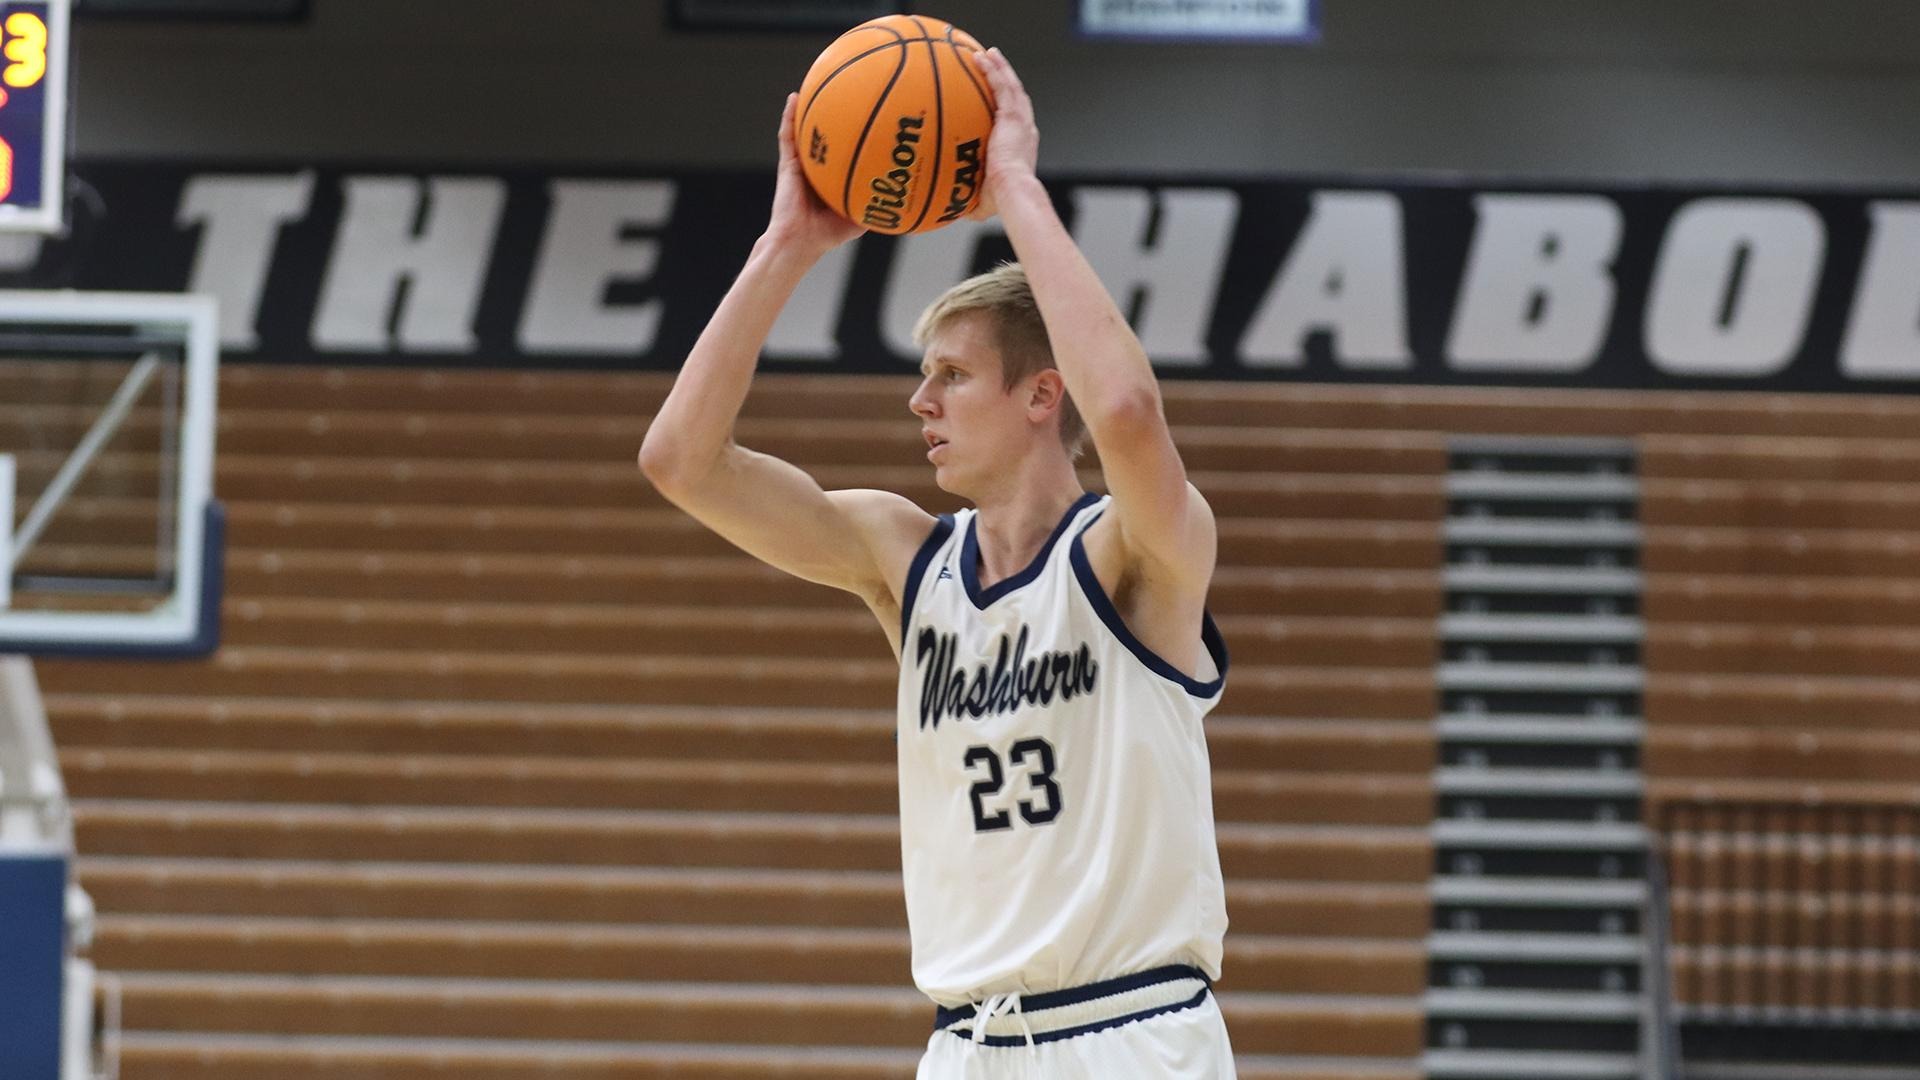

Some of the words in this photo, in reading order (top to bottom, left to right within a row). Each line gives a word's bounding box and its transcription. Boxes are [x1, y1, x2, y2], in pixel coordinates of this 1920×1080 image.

[0, 12, 48, 88] 3
[862, 115, 924, 229] Wilson
[936, 137, 982, 223] NCAA
[175, 171, 678, 355] THE
[916, 622, 1099, 731] Washburn
[963, 735, 1064, 834] 23
